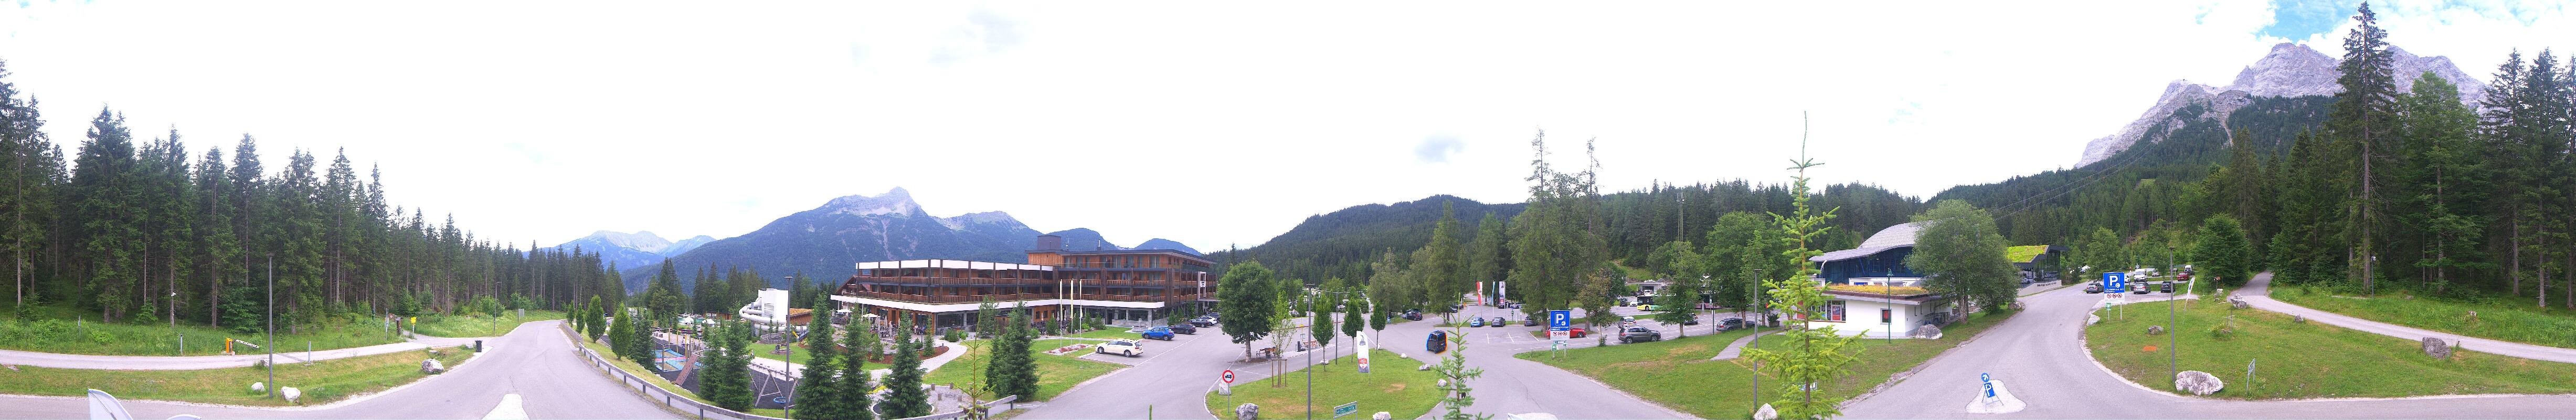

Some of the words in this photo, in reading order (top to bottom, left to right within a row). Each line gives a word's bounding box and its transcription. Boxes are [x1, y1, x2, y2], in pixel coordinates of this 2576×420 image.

[2109, 275, 2118, 286] P
[1556, 313, 1564, 324] P
[1985, 384, 1992, 397] P
